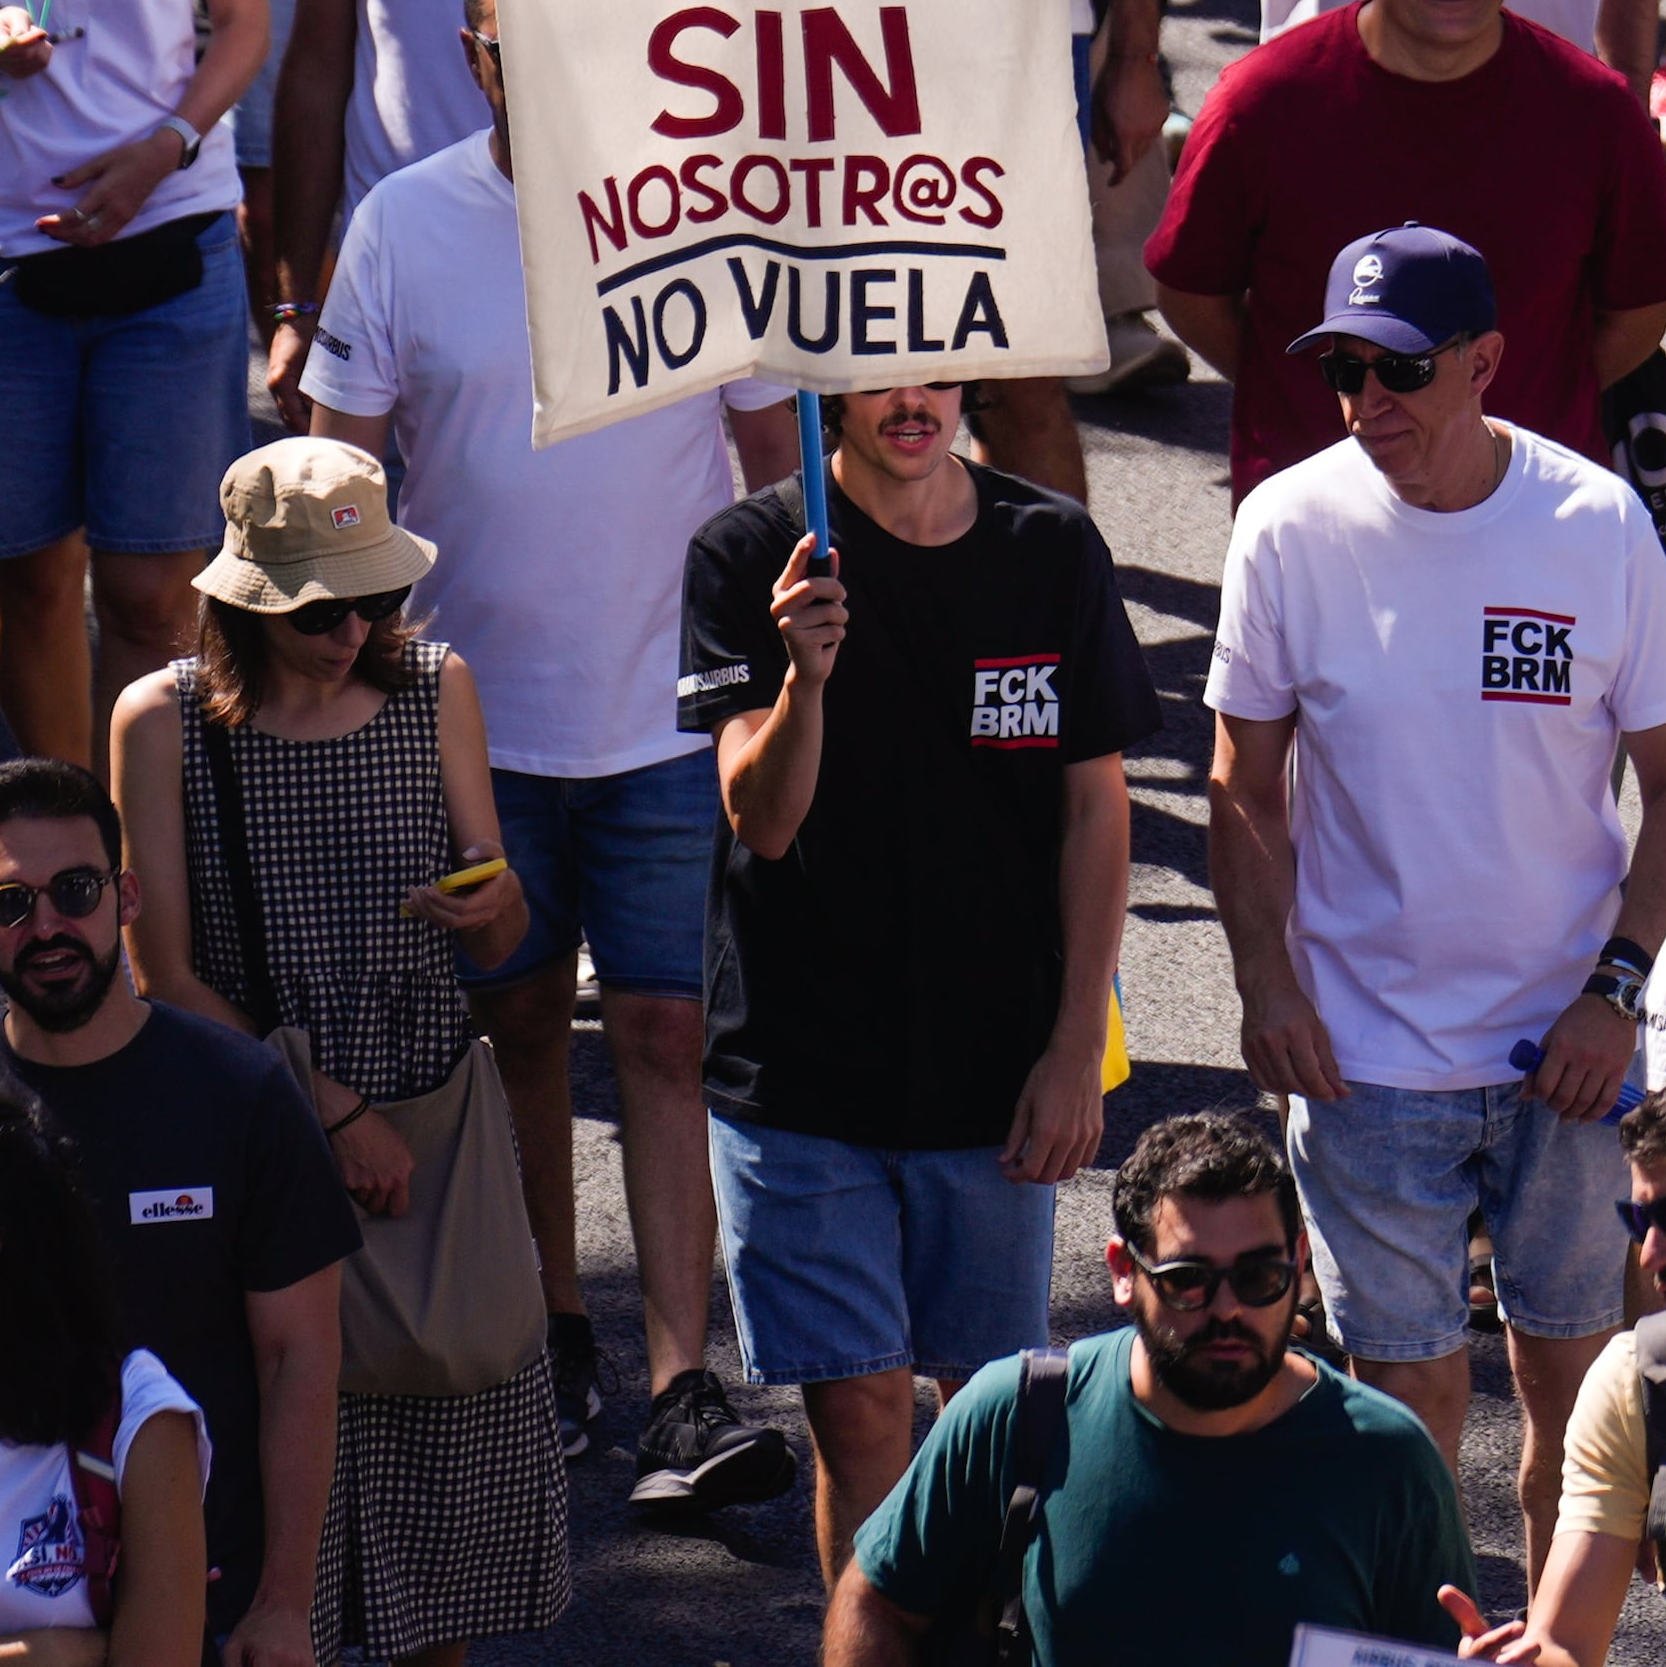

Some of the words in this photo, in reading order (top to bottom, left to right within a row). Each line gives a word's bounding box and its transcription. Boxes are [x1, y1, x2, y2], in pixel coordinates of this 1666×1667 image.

[647, 5, 922, 143] SIN
[577, 153, 1006, 265] NOSOTR@S
[601, 278, 707, 396] NO
[726, 257, 1010, 355] VUELA
[1483, 619, 1573, 660] FCK
[973, 665, 1059, 706] FCK
[1482, 655, 1571, 694] BRM
[970, 701, 1059, 739] BRM
[141, 1201, 204, 1219] ellesse
